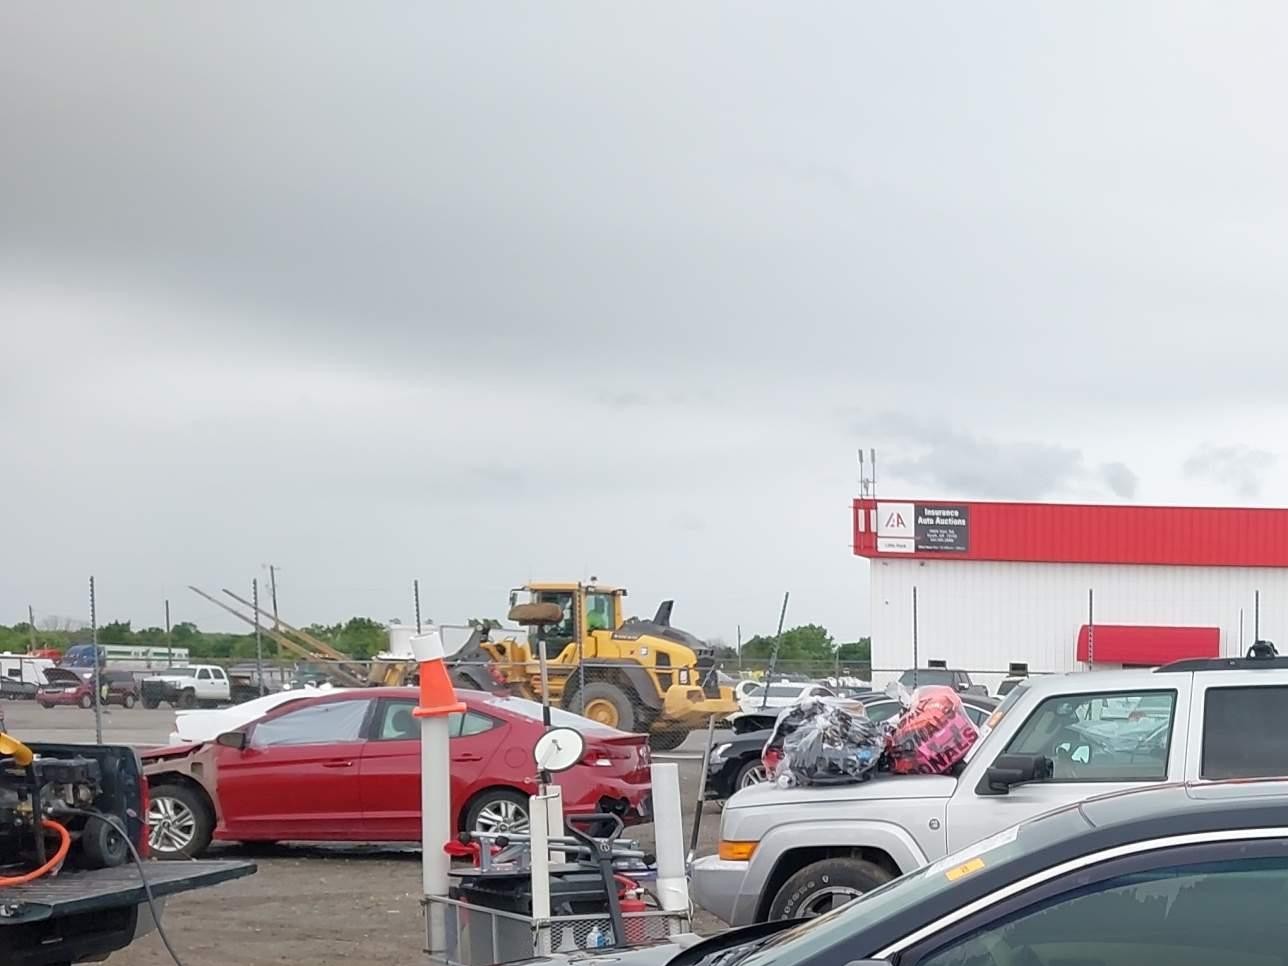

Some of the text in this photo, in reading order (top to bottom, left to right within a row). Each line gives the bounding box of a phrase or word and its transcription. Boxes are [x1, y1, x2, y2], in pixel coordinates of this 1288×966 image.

[924, 508, 959, 517] Insurance
[918, 516, 966, 526] Auto Auctions
